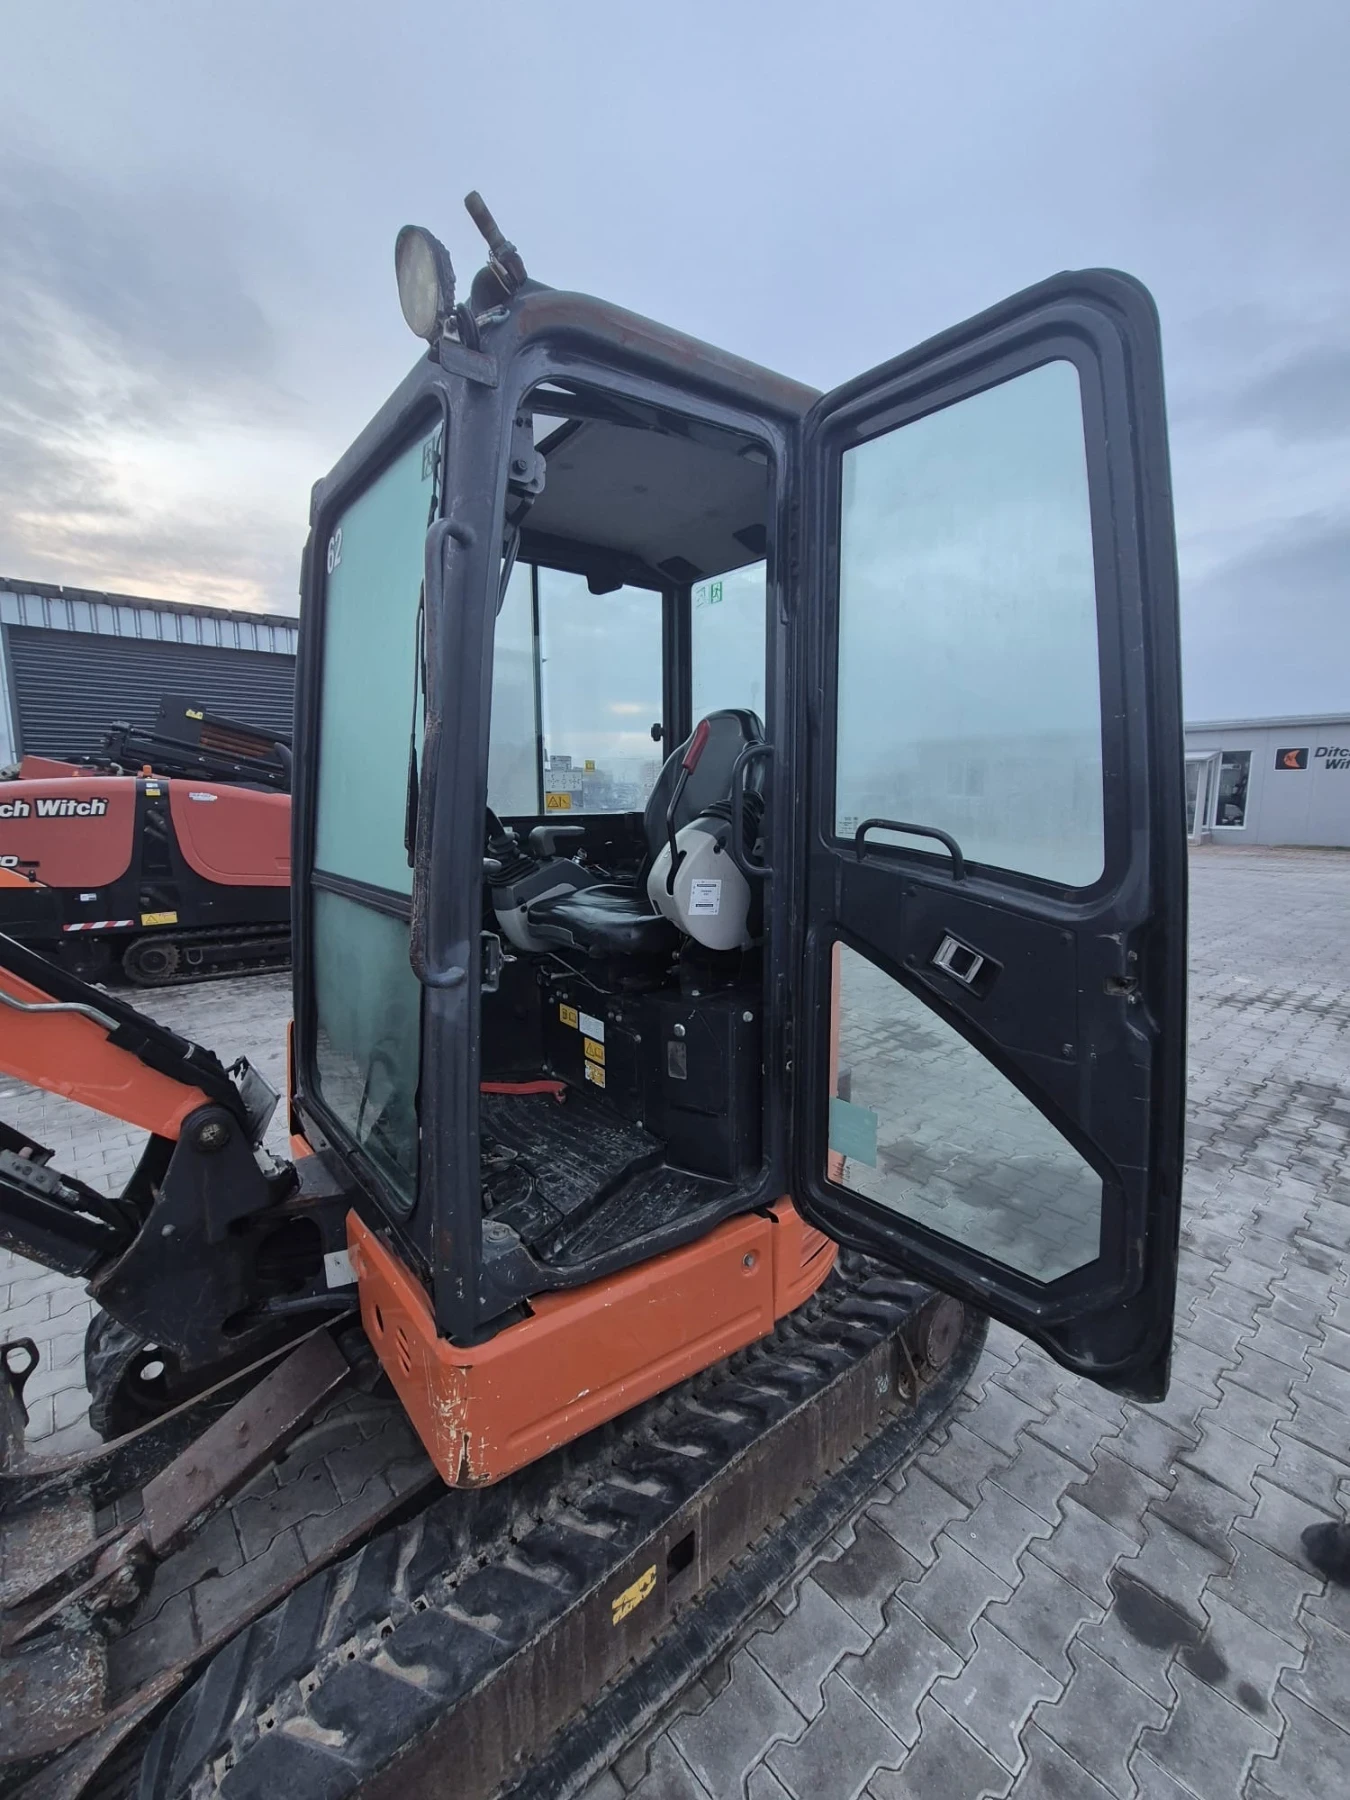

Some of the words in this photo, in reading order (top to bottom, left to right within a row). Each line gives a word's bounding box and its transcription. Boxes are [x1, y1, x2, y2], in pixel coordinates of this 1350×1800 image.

[1314, 746, 1350, 758] Ditc
[36, 799, 106, 816] Witch
[0, 855, 19, 867] 0
